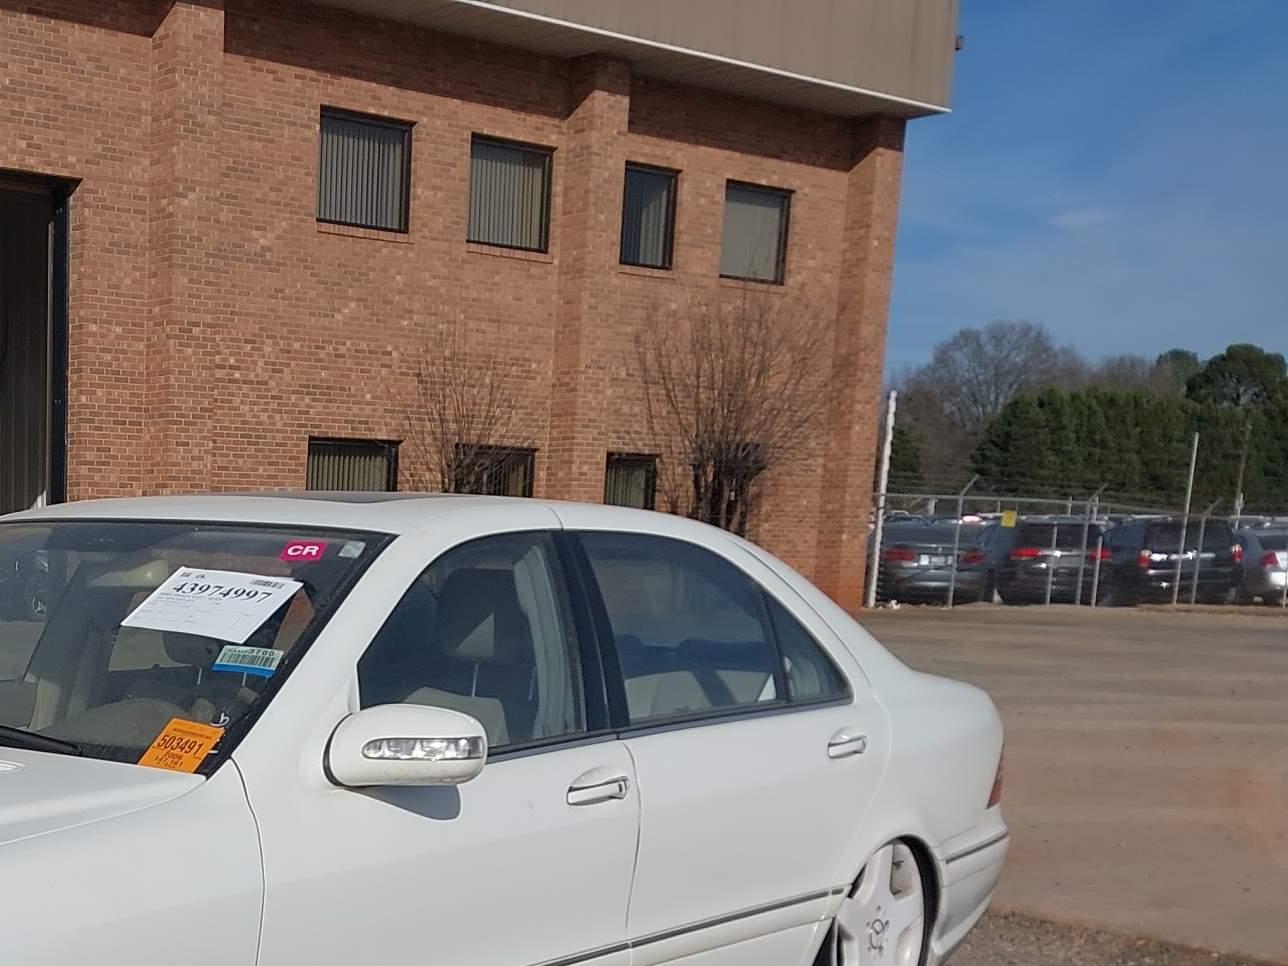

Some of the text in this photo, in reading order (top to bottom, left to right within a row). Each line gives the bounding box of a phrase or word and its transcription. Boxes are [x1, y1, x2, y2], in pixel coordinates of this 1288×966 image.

[287, 545, 320, 556] CR
[172, 581, 273, 603] 43974997
[156, 734, 204, 756] 503491
